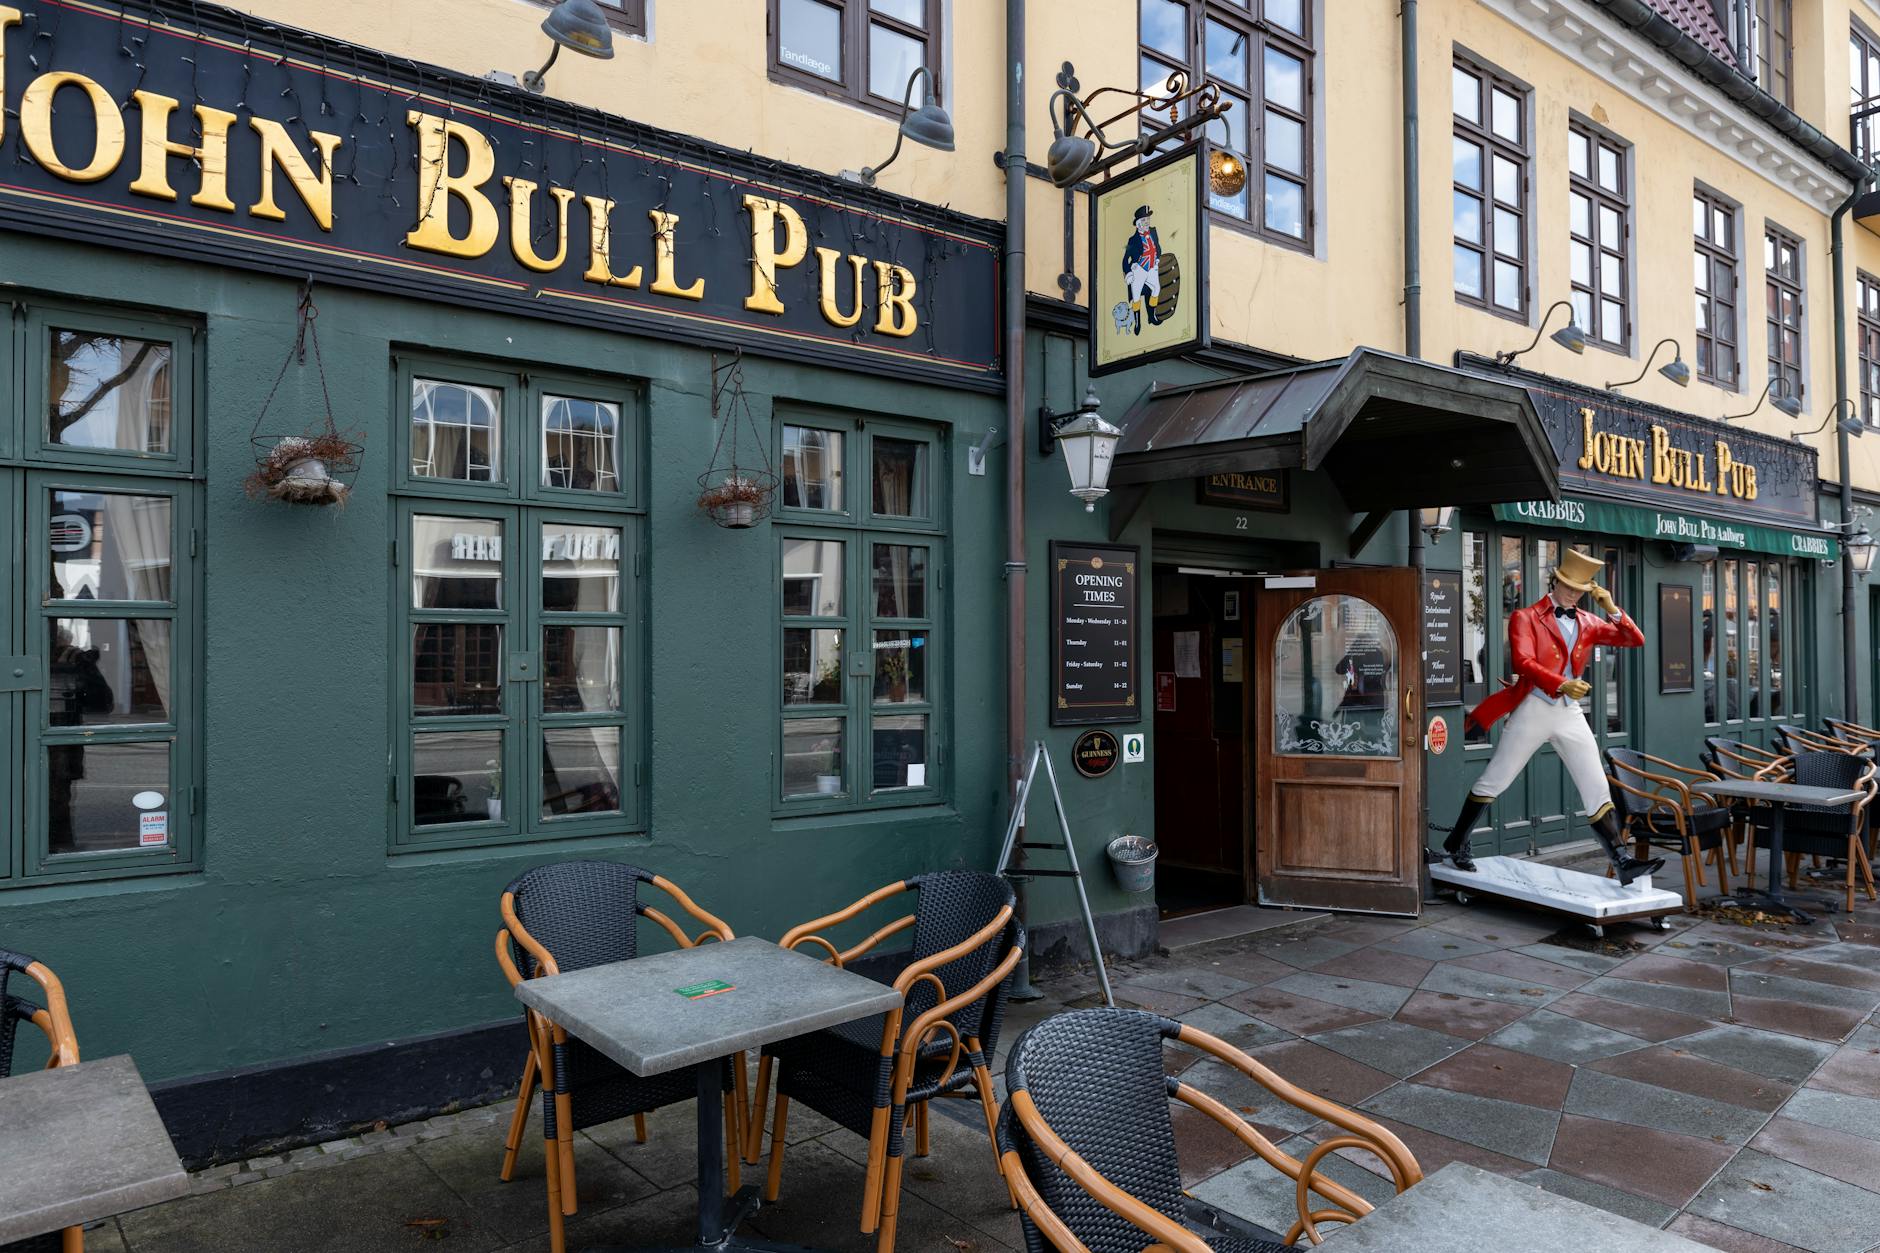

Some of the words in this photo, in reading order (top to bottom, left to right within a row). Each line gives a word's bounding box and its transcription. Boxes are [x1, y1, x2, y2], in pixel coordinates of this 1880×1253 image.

[780, 46, 831, 73] Tandlæge
[1212, 473, 1277, 493] ENTRANCE
[1236, 516, 1248, 529] 22
[1717, 525, 1745, 547] Aalborg
[1792, 534, 1829, 555] CRABBIES
[1075, 574, 1123, 588] OPENING
[1083, 590, 1115, 602] TIMES
[1066, 617, 1084, 625] Monday
[1088, 618, 1111, 626] Wednesday
[1066, 639, 1087, 647] Thursday
[1083, 661, 1103, 669] Saturday
[1082, 749, 1112, 758] GUINNESS
[143, 815, 165, 823] ALARM
